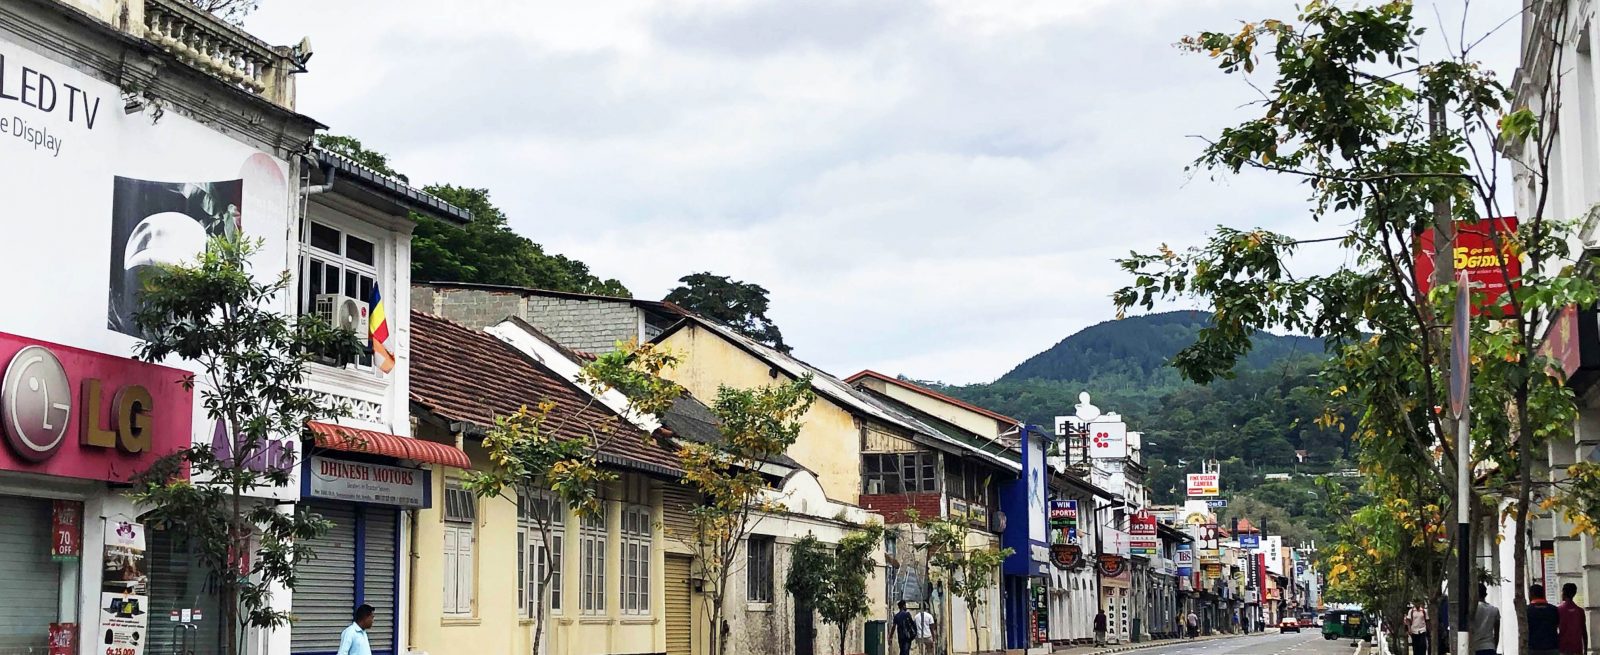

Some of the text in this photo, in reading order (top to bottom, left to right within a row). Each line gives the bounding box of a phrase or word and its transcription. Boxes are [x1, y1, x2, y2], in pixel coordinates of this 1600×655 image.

[63, 83, 100, 130] TV
[13, 116, 62, 157] Display
[79, 378, 153, 453] LG
[321, 460, 413, 485] DHINESH MOTORS
[1051, 509, 1076, 517] SPORTS
[58, 530, 71, 546] 70
[58, 545, 72, 555] OFF
